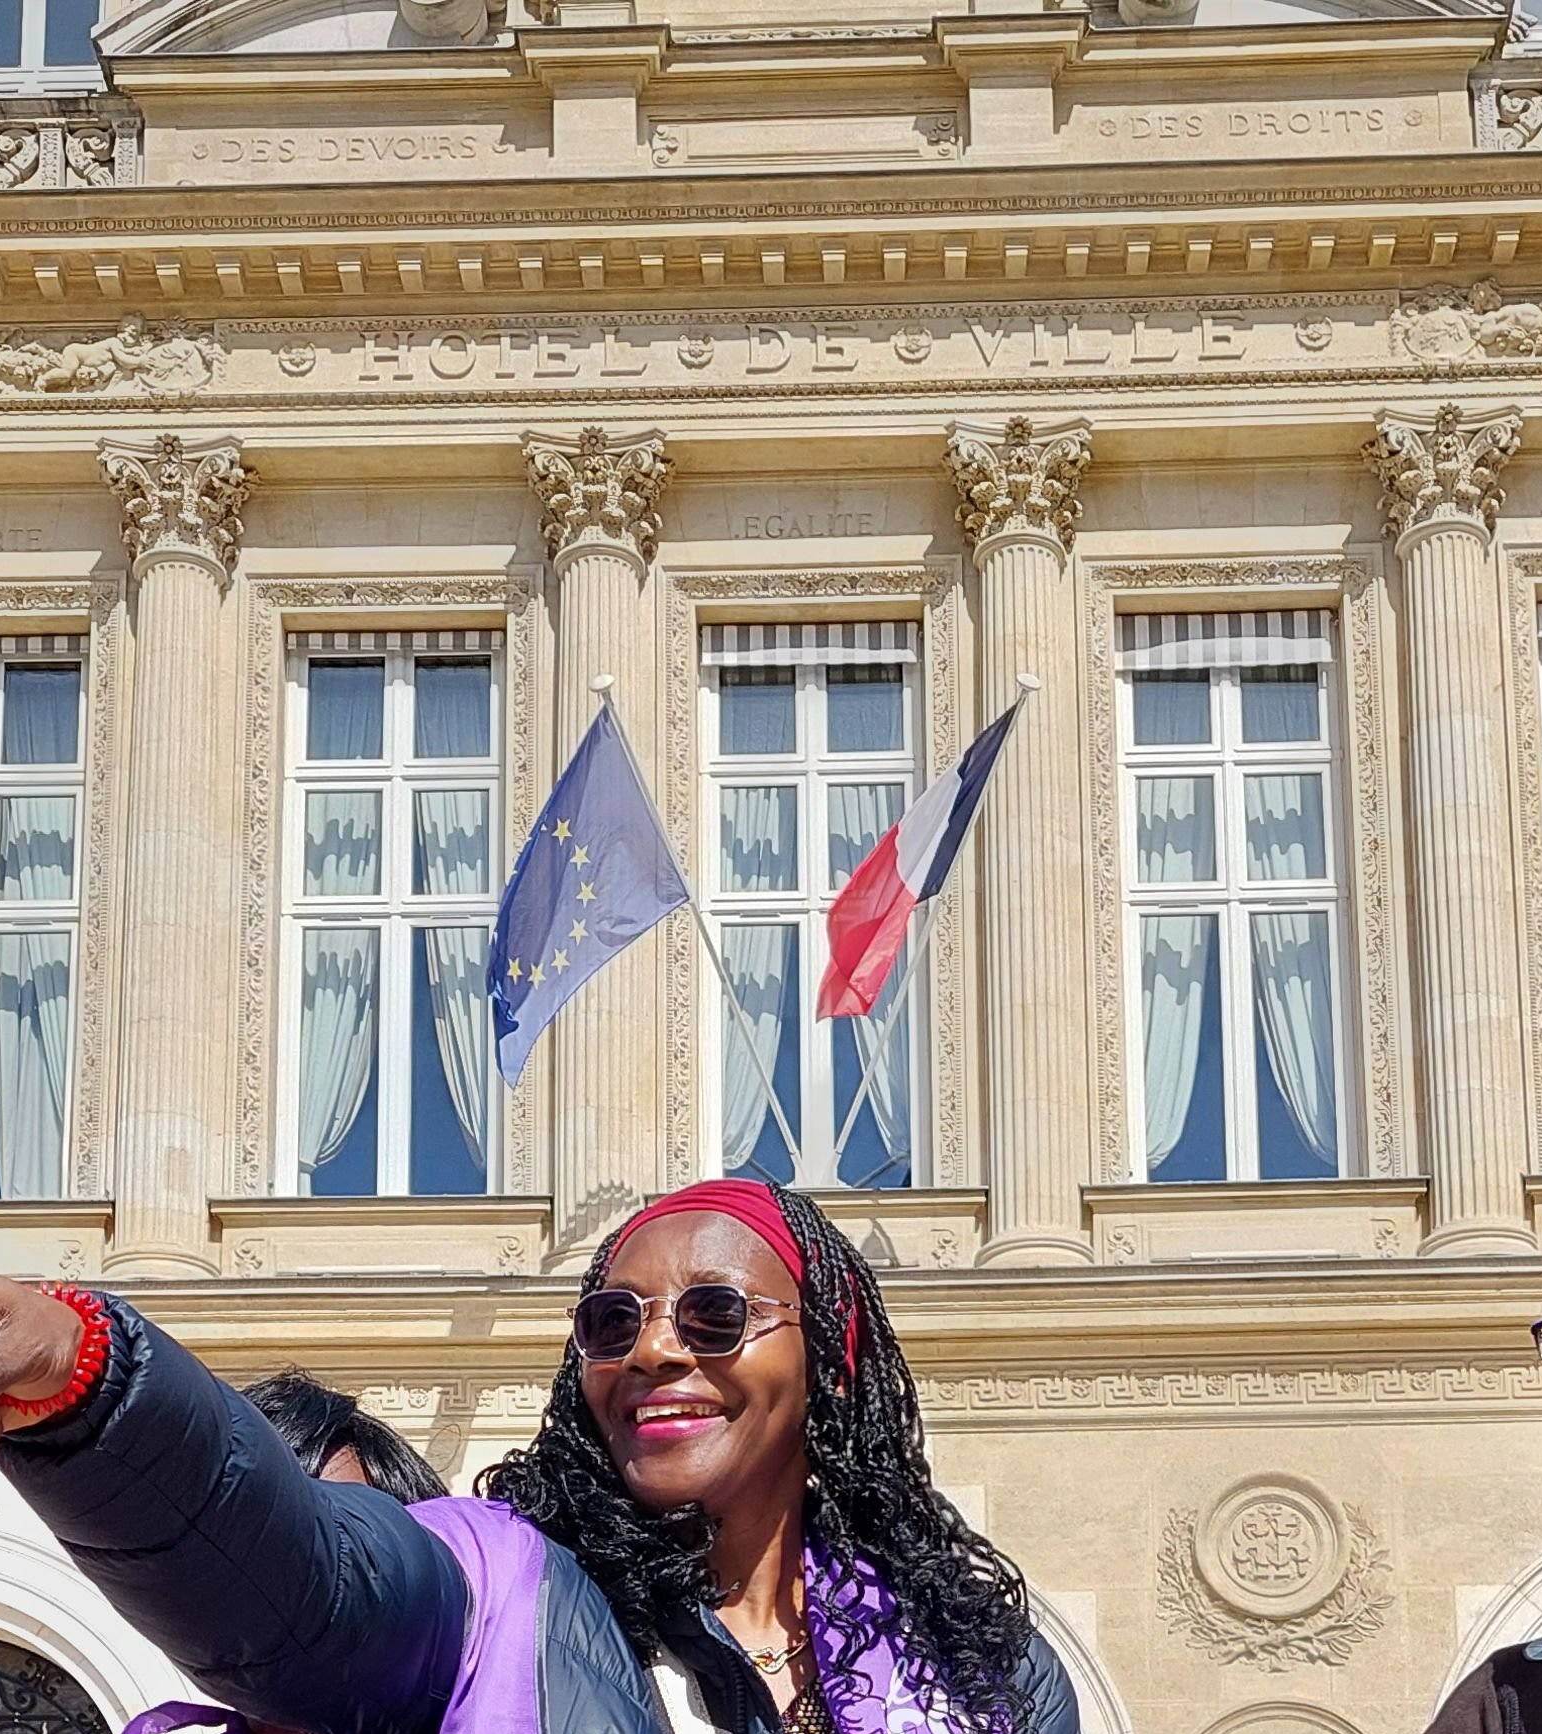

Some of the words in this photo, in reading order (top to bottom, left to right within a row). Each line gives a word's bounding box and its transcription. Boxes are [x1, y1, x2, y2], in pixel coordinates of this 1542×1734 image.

[1130, 114, 1203, 138] DES
[1229, 109, 1384, 136] DROITS
[222, 139, 296, 163] DES
[318, 136, 477, 161] DEVOIRS
[359, 327, 648, 381] HOTEL
[745, 323, 858, 375] DE
[964, 309, 1247, 367] VILLE
